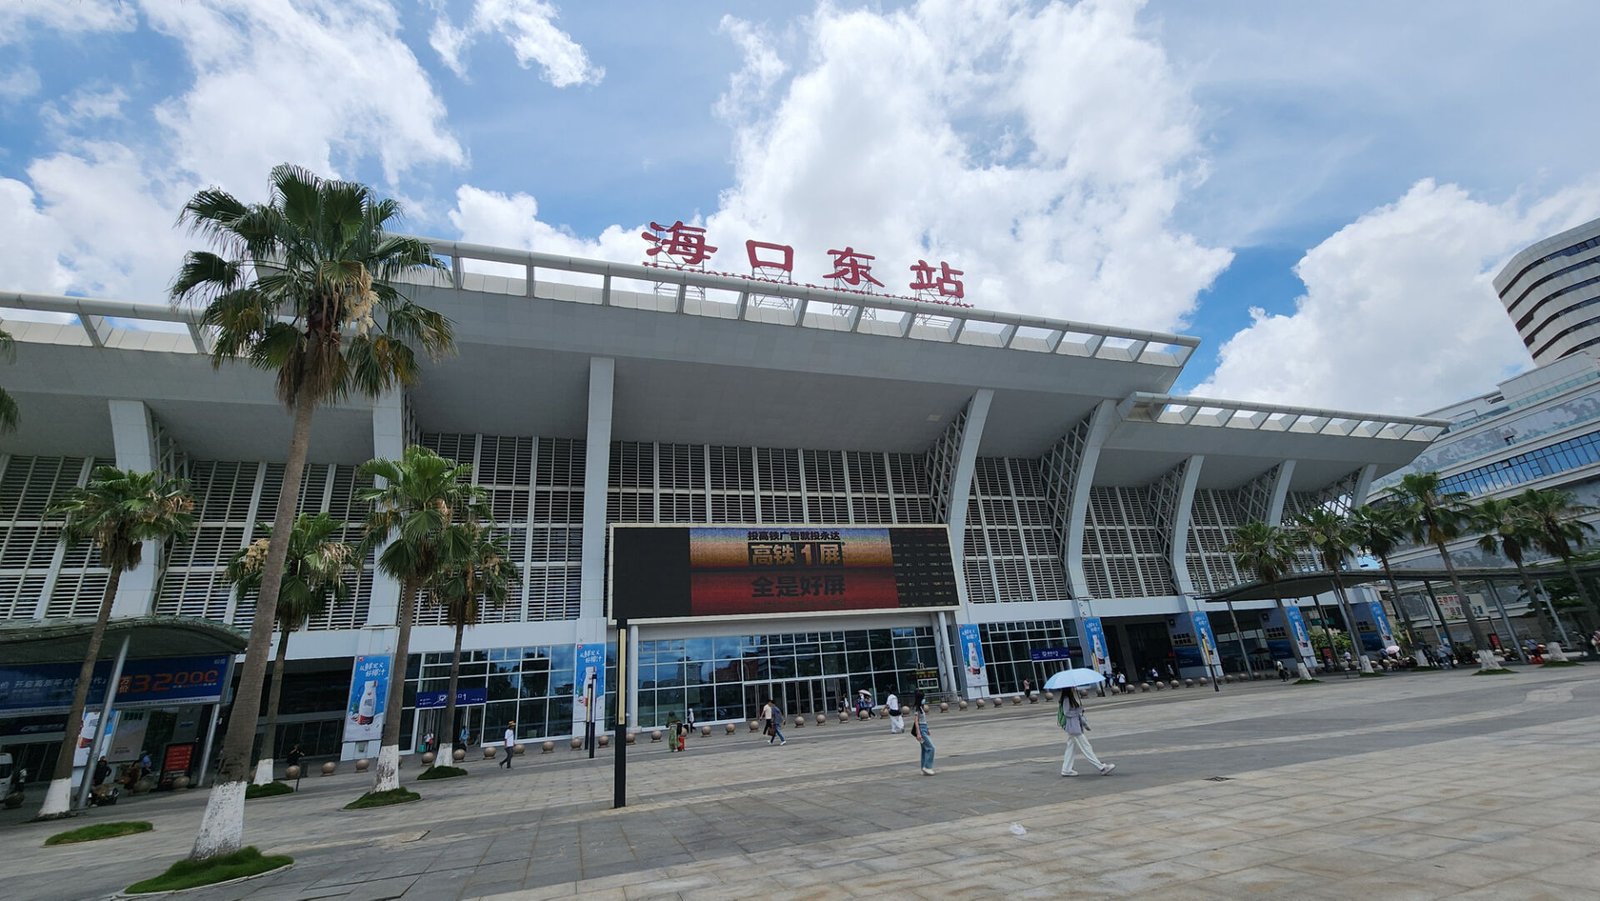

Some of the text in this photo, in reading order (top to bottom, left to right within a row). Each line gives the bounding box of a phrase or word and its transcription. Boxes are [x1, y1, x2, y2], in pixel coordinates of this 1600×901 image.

[641, 220, 965, 299] 海口东站
[750, 543, 841, 565] 高铁1屏
[752, 575, 846, 598] 全是好屏
